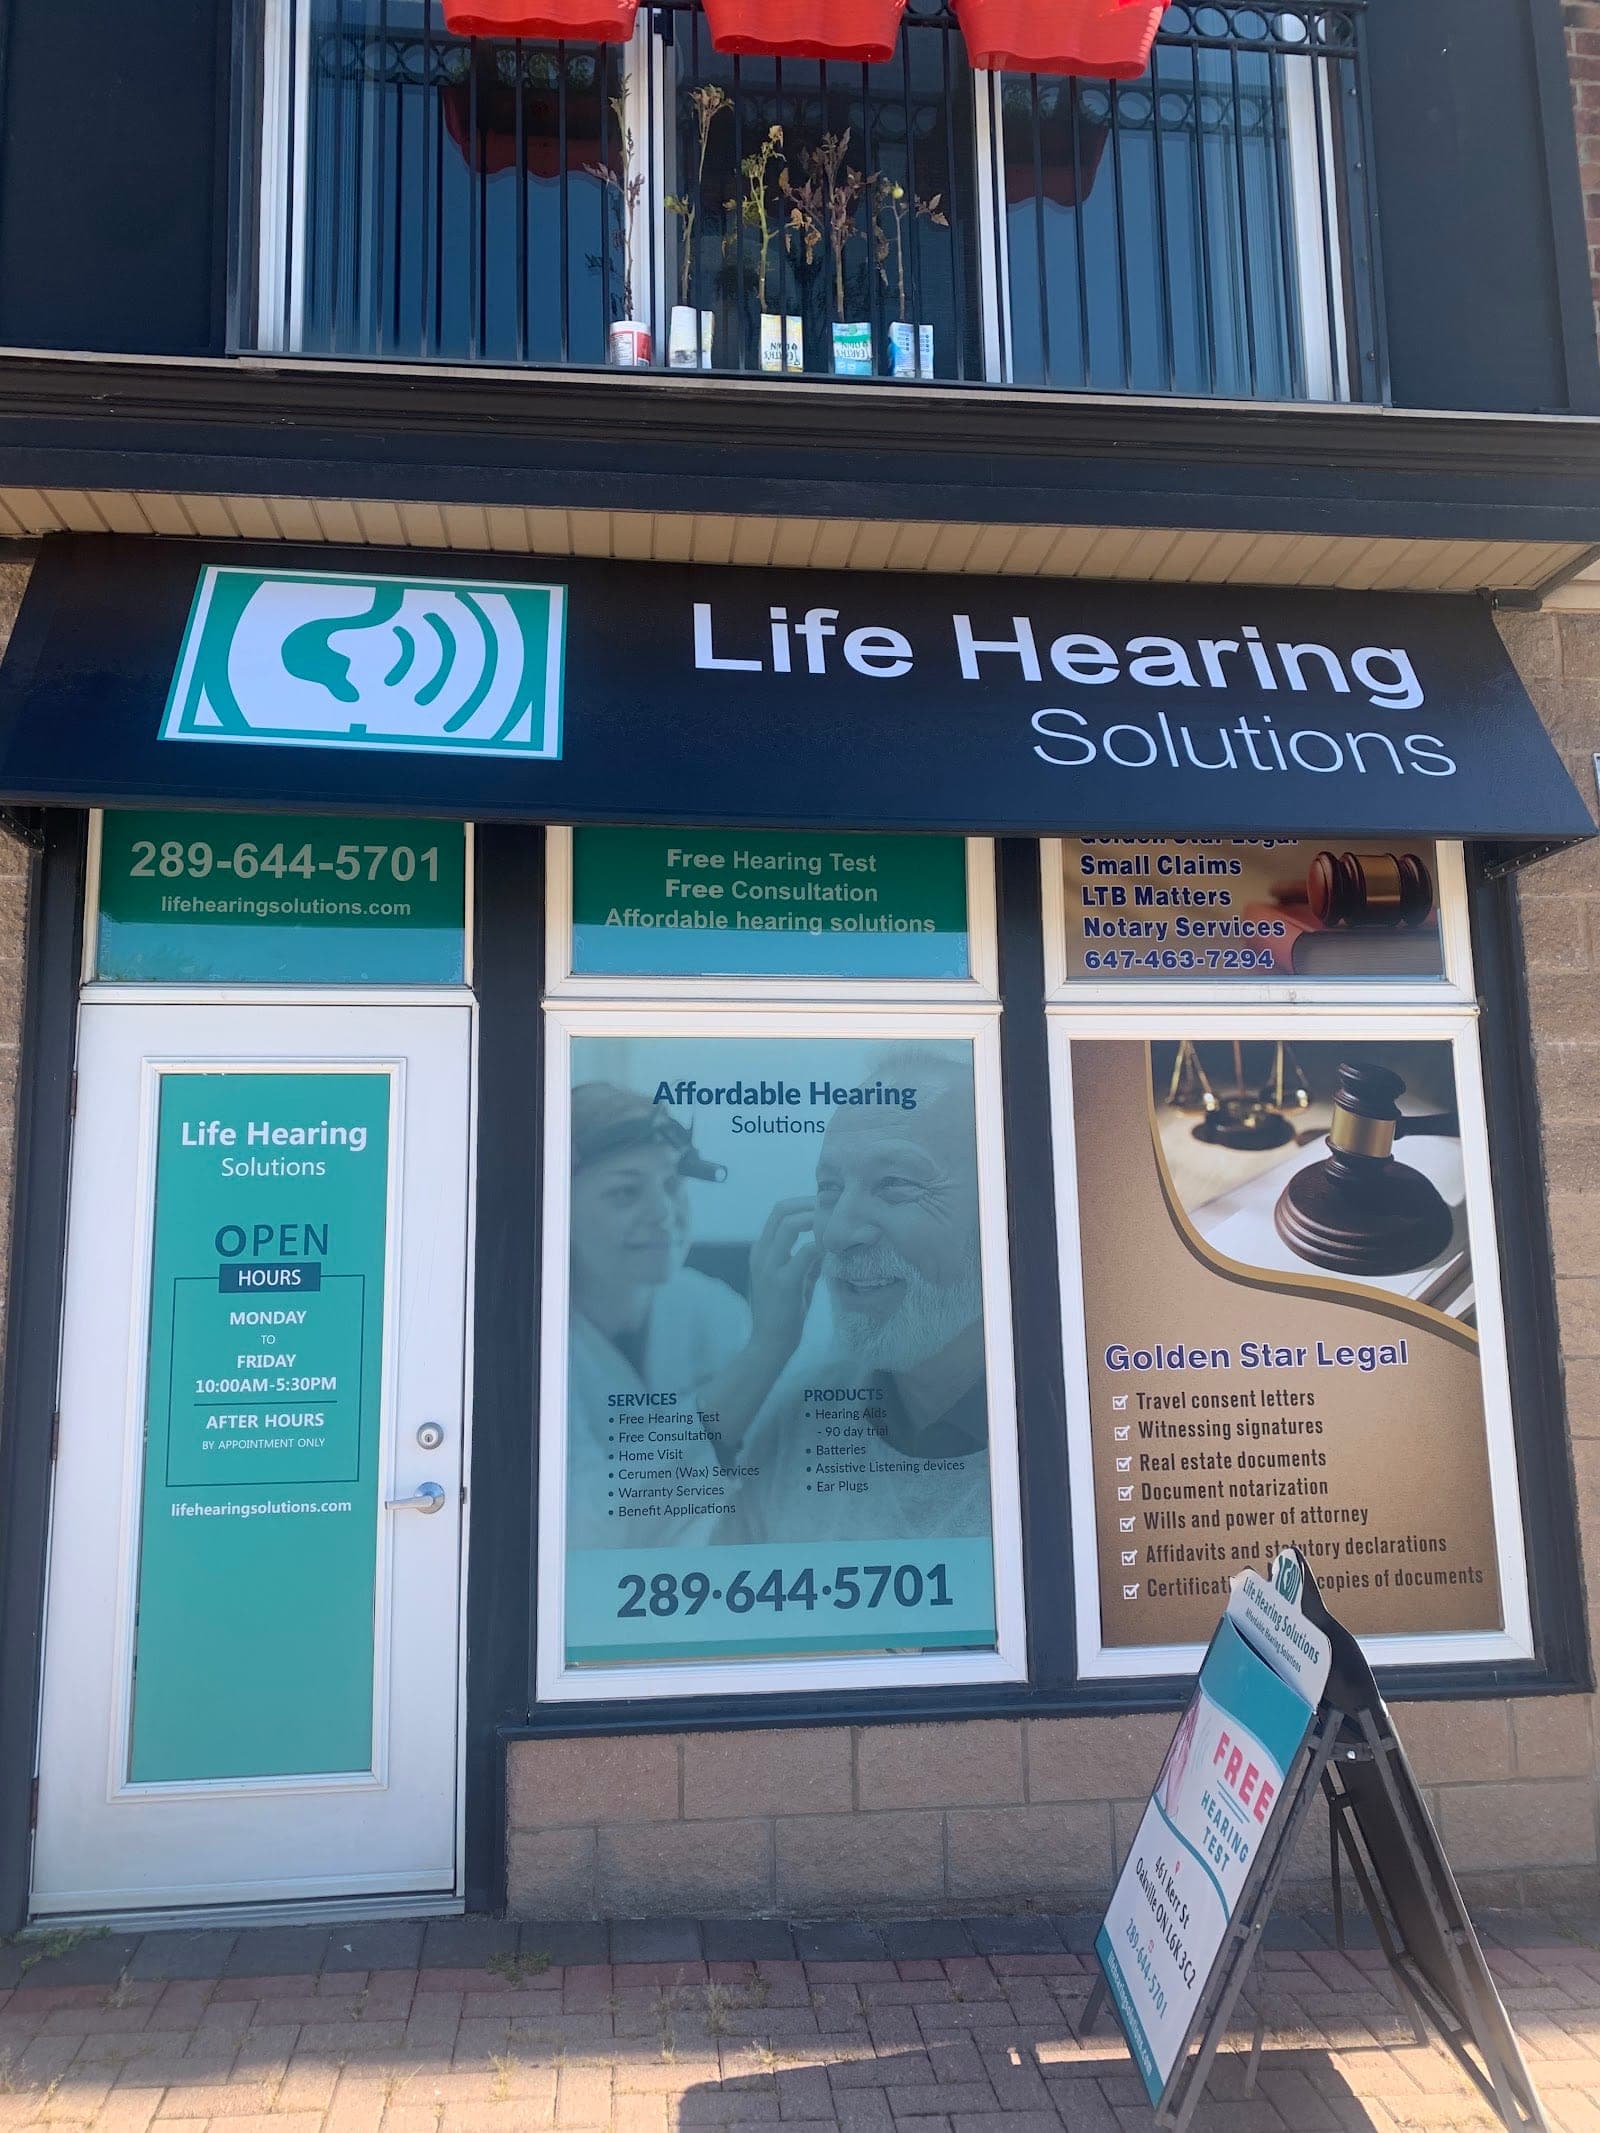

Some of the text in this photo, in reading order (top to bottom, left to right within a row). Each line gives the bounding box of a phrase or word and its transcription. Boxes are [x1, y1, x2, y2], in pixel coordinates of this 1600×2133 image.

[693, 602, 1425, 709] Life Hearing
[1031, 708, 1457, 776] Solutions
[130, 841, 438, 882] 289-644-5701
[667, 849, 876, 875] Free Hearing Test
[1080, 855, 1241, 876] Small Claims
[665, 879, 877, 902] Free Consultation
[1082, 886, 1232, 906] LTB Matters
[161, 896, 411, 917] lifehearingsolutions.com
[605, 908, 935, 935] Affordable hearing solutions
[1083, 916, 1285, 941] Notary Services
[1084, 950, 1274, 969] 647-463-7294
[652, 1080, 917, 1110] Affordable Hearing
[731, 1115, 825, 1134] Solutions
[182, 1121, 367, 1151] Life Hearing
[221, 1157, 326, 1176] Solutions
[215, 1224, 328, 1257] OPEN
[238, 1269, 301, 1286] HOURS
[230, 1311, 307, 1325] MONDAY
[261, 1335, 275, 1344] TO
[237, 1354, 296, 1368] FRIDAY
[1104, 1339, 1408, 1371] Golden Star Legal
[195, 1376, 337, 1393] 10:00AM-5:30PM
[804, 1388, 884, 1402] PRODUCTS
[608, 1393, 677, 1407] SERVICES
[1136, 1389, 1315, 1410] Travel consent letters
[206, 1413, 324, 1429] AFTER HOURS
[619, 1411, 720, 1425] Free Hearing Test
[815, 1407, 887, 1421] Hearing Aids
[619, 1430, 722, 1443] Free Consultation
[825, 1426, 888, 1439] 90 day trial
[1138, 1418, 1323, 1441] Witnessing signatures
[202, 1438, 325, 1450] BY APPOINTMENT ONLY
[816, 1444, 866, 1456] Batteries
[619, 1449, 684, 1461] Home Visit
[1140, 1449, 1326, 1472] Real estate documents
[618, 1465, 760, 1480] Cerumen (Wax) Services
[816, 1459, 965, 1474] Assistive Listening devices
[618, 1485, 725, 1499] Warranty Services
[817, 1480, 869, 1493] Ear Plugs
[1142, 1479, 1328, 1501] Document notarization
[171, 1501, 351, 1518] lifehearingsolutions.com
[618, 1503, 736, 1517] Benefit Applications
[1144, 1506, 1368, 1530] Wills and power of attorney
[1146, 1542, 1226, 1563] Affidavits
[1232, 1540, 1260, 1559] and
[1345, 1535, 1447, 1556] declarations
[1317, 1571, 1370, 1592] copies
[1375, 1569, 1390, 1587] of
[1395, 1566, 1483, 1587] documents
[1243, 1576, 1320, 1664] Life Hearing Solutions
[1213, 1731, 1275, 1824] FREE
[1200, 1790, 1249, 1864] HEARING
[1202, 1826, 1230, 1872] TEST
[1155, 1856, 1190, 1930] 461 Kerr St
[1136, 1857, 1196, 1990] Oakville ON L6K 3C2
